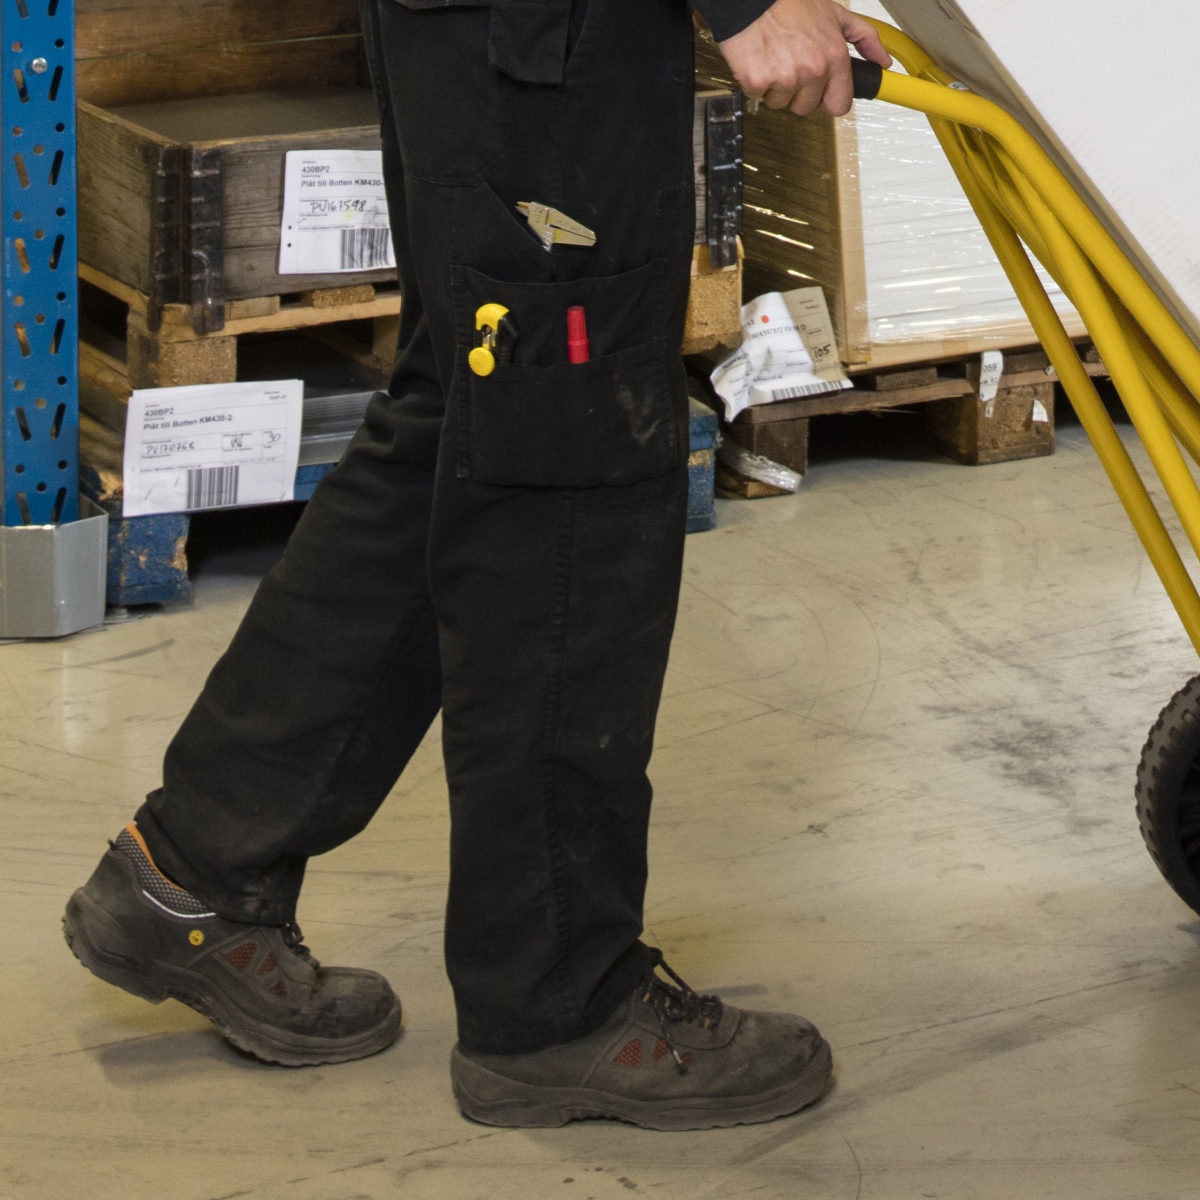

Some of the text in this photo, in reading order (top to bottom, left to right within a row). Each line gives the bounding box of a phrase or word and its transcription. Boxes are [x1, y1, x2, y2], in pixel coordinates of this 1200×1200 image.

[317, 179, 327, 187] till
[329, 179, 352, 187] Botten
[354, 178, 384, 186] KM430-
[145, 407, 174, 417] 430BP2
[160, 421, 171, 429] till
[172, 419, 197, 428] Botten
[199, 414, 232, 423] KM430-2
